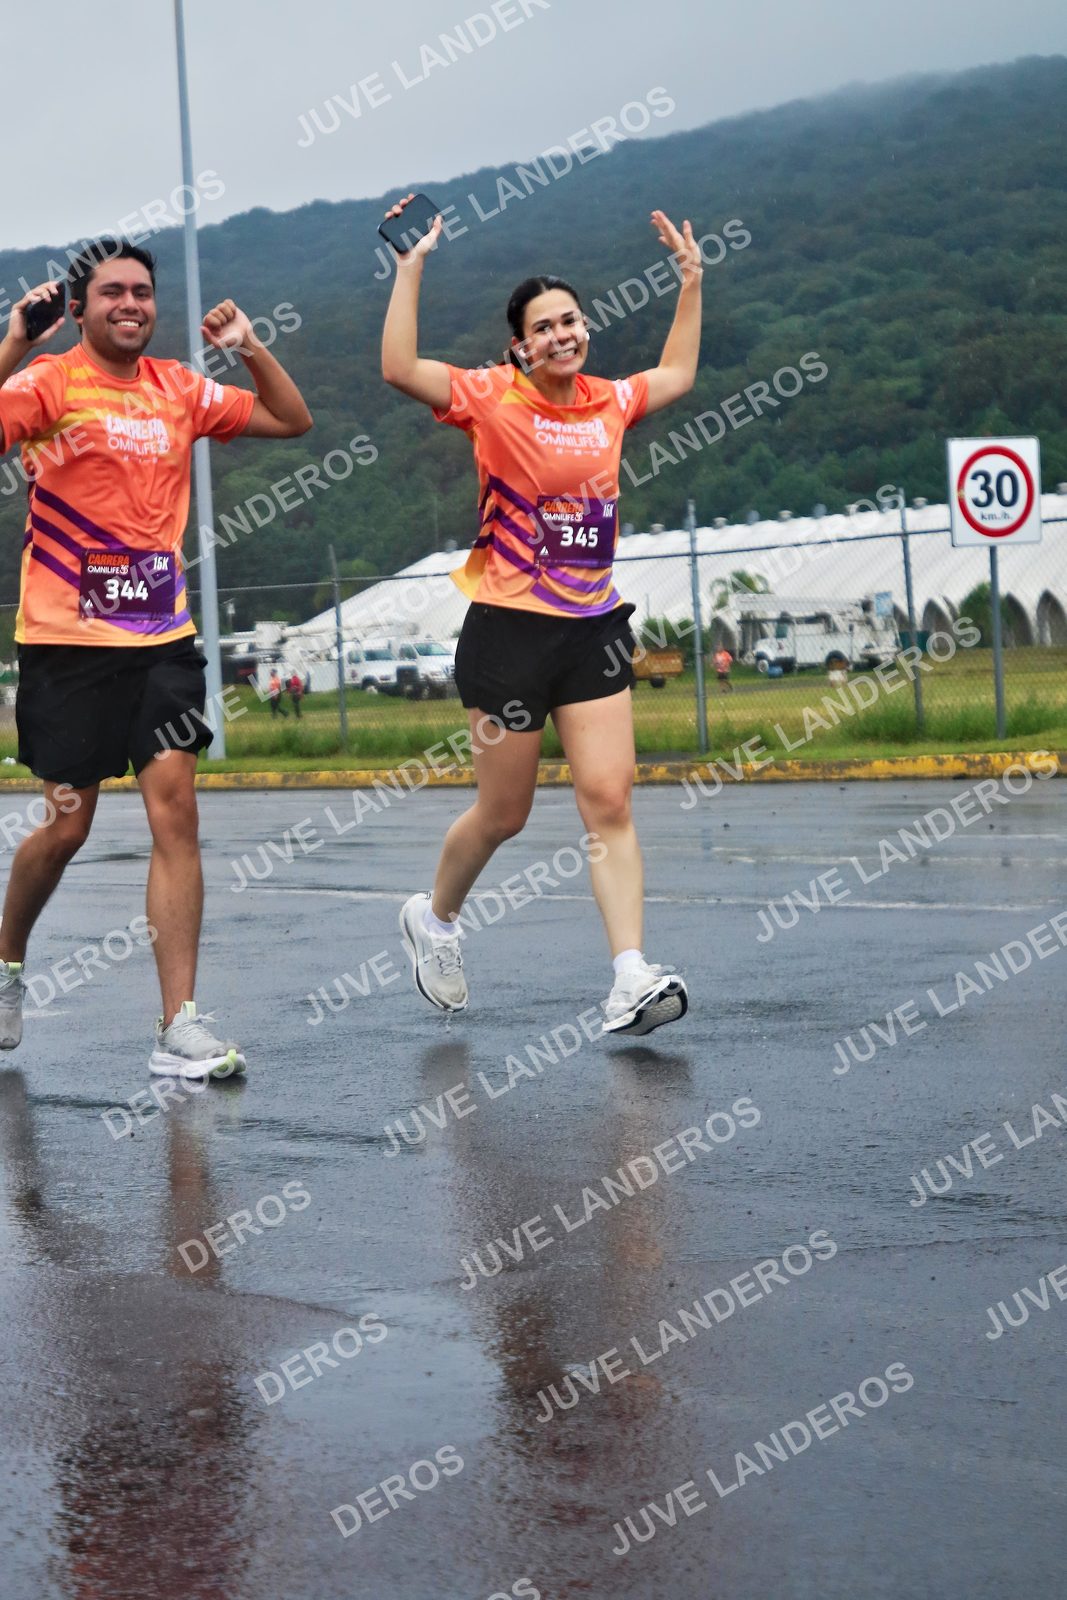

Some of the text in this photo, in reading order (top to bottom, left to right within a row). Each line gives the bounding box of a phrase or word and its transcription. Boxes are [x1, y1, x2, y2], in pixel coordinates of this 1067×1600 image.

[970, 469, 1019, 508] 30
[543, 501, 584, 512] CARRERA
[542, 513, 574, 521] OMNILIFE
[560, 526, 598, 547] 345
[88, 554, 130, 565] CARRERA
[87, 565, 119, 574] OMNILIFE
[106, 579, 149, 600] 344
